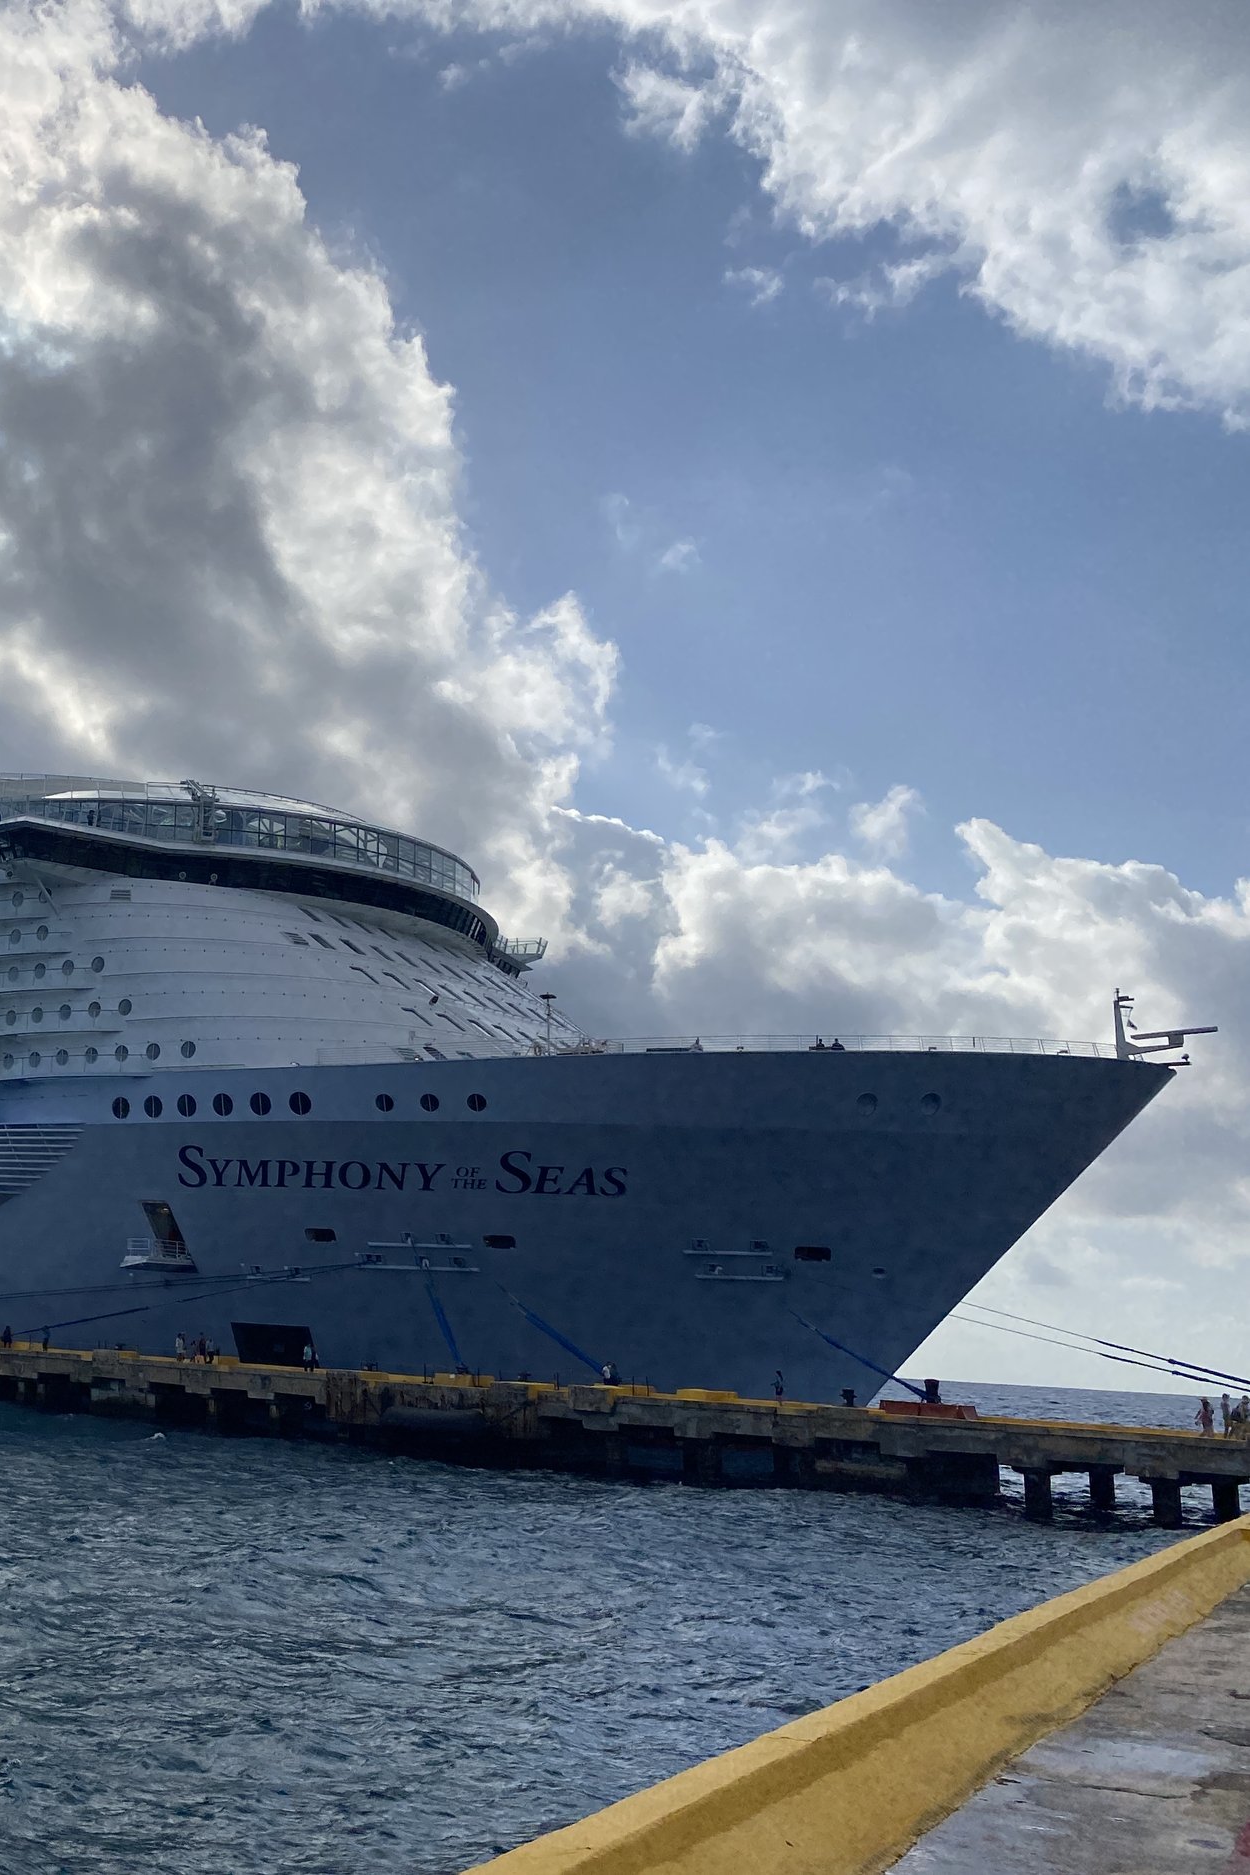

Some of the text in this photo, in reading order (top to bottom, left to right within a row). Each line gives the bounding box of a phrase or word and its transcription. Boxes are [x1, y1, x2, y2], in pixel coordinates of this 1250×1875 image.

[177, 1145, 628, 1197] SYMPHONY OF THE SEAS
